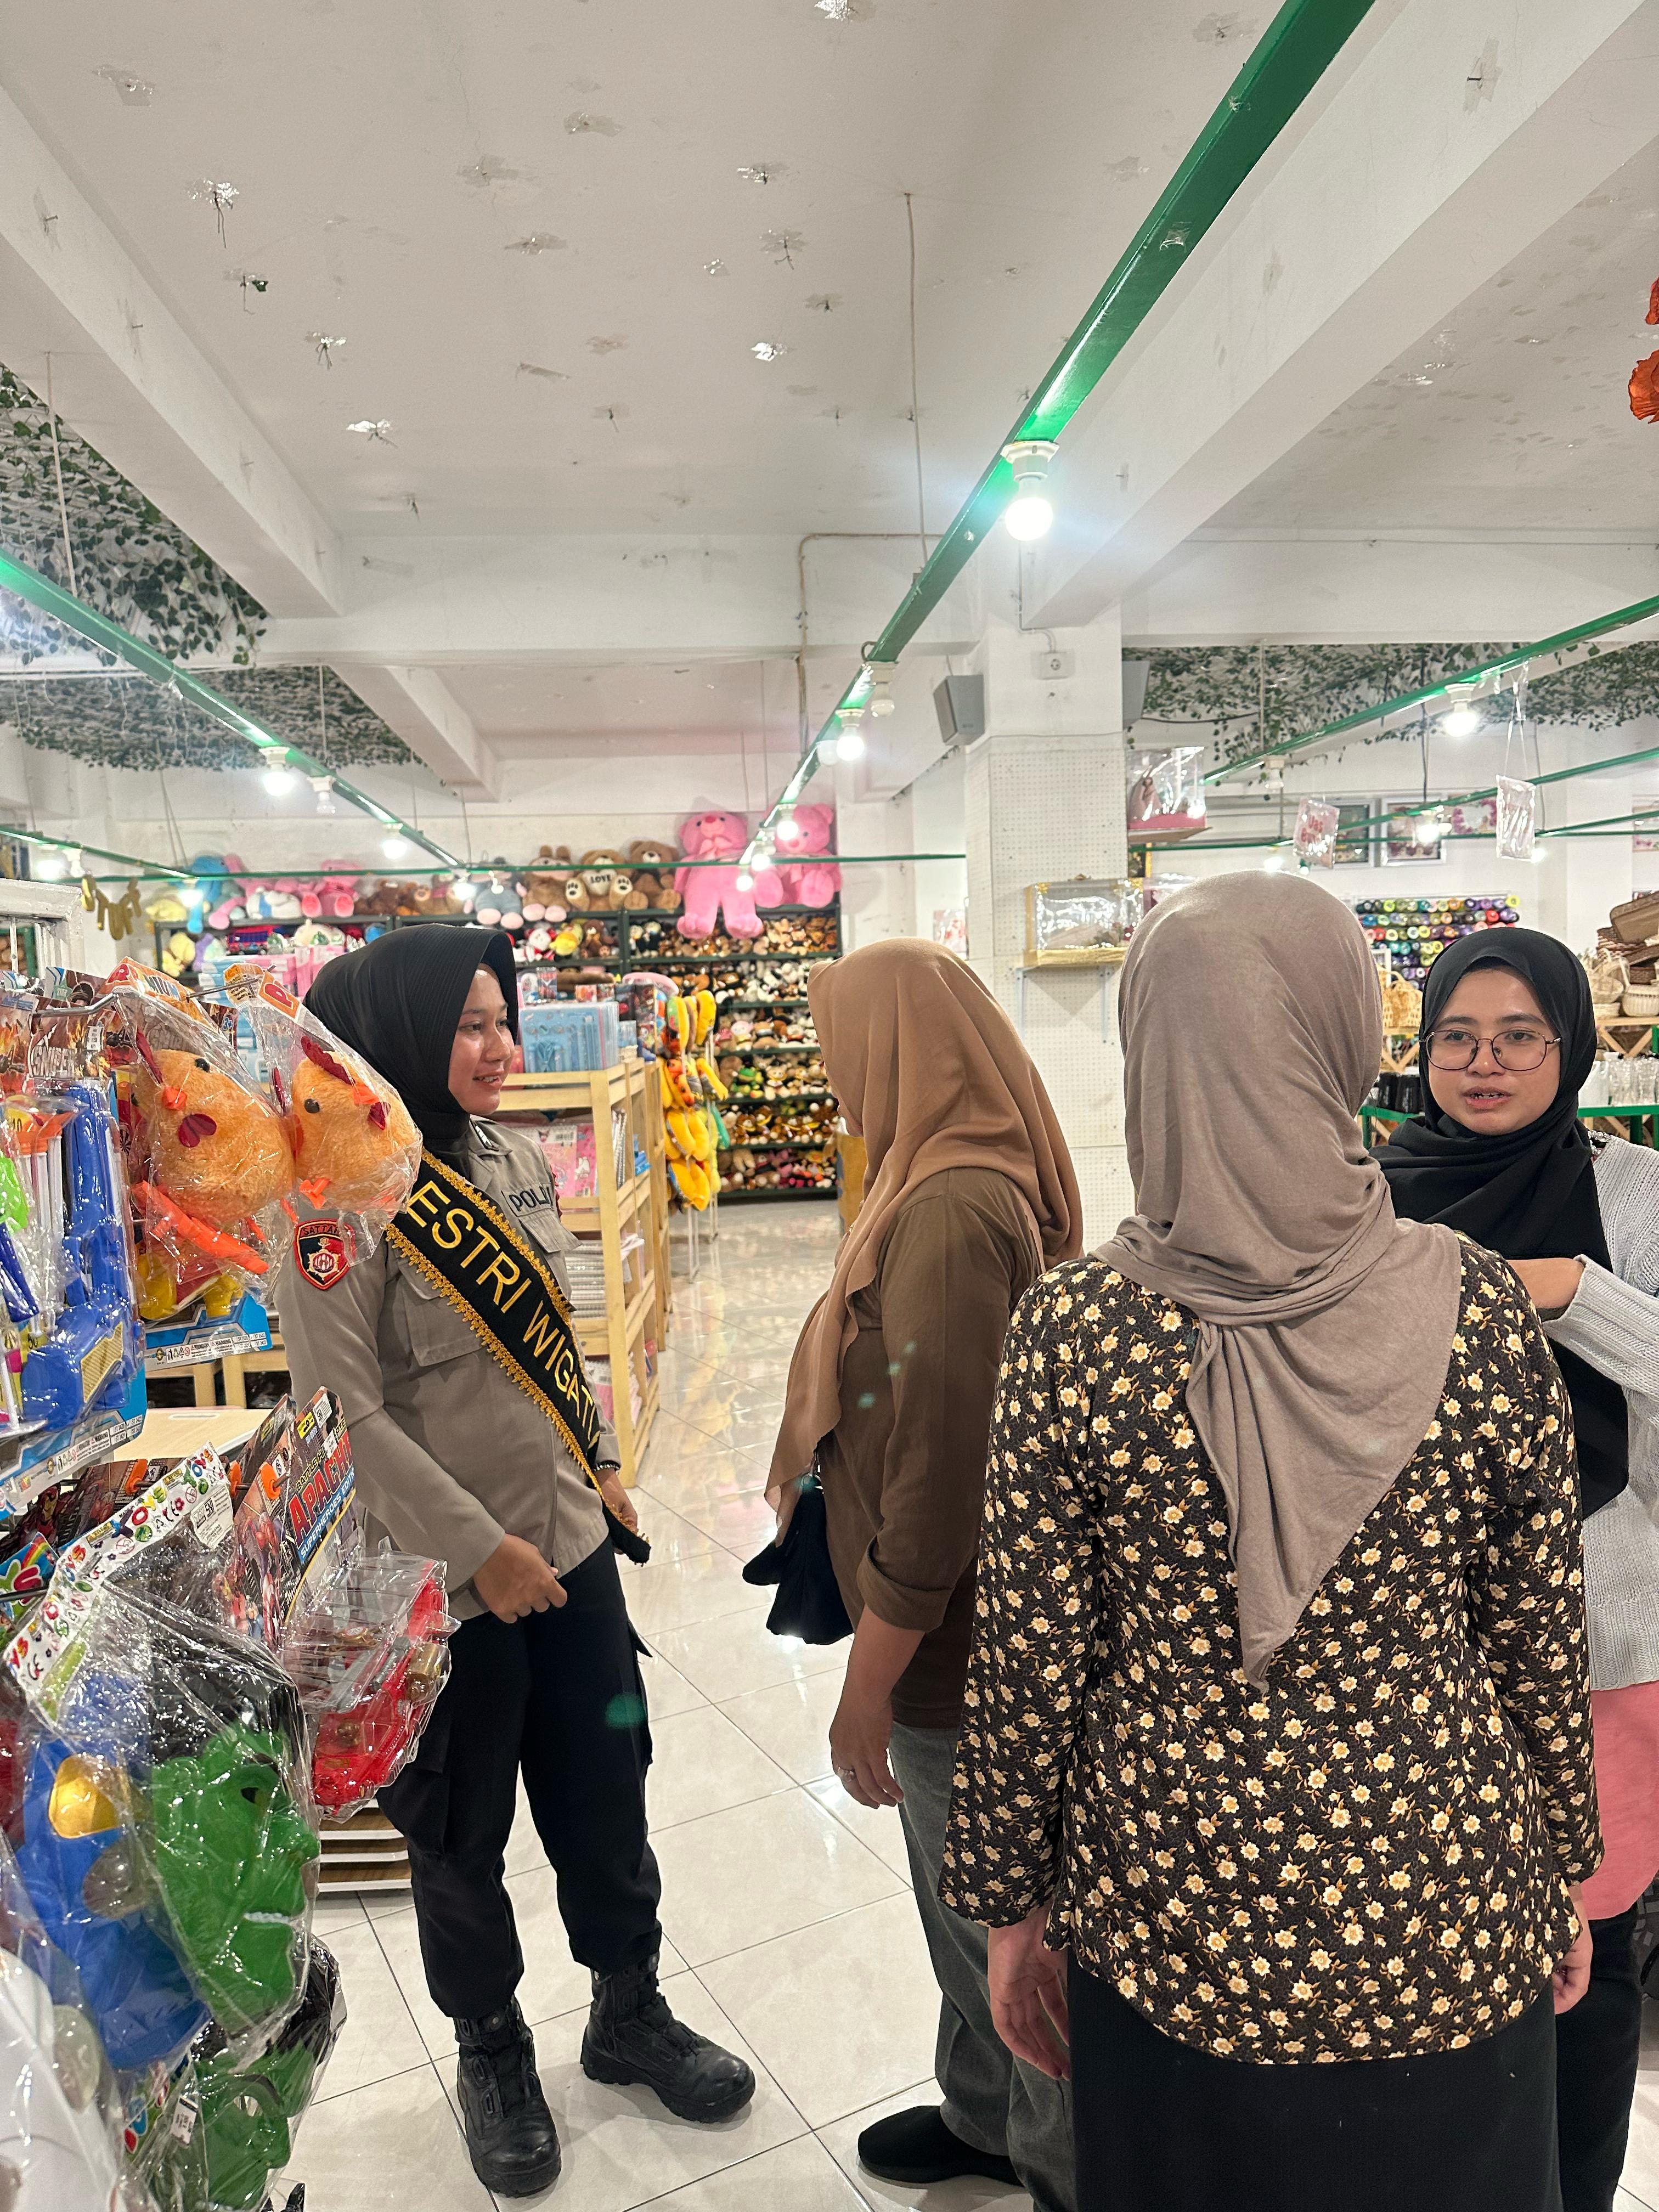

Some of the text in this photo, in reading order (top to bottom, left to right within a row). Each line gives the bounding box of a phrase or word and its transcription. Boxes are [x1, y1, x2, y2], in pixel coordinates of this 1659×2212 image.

[590, 874, 611, 883] LOVE
[407, 1181, 532, 1313] ESTRI
[296, 1457, 318, 1492] BATTLE
[301, 1493, 342, 1559] SUPERHEROES
